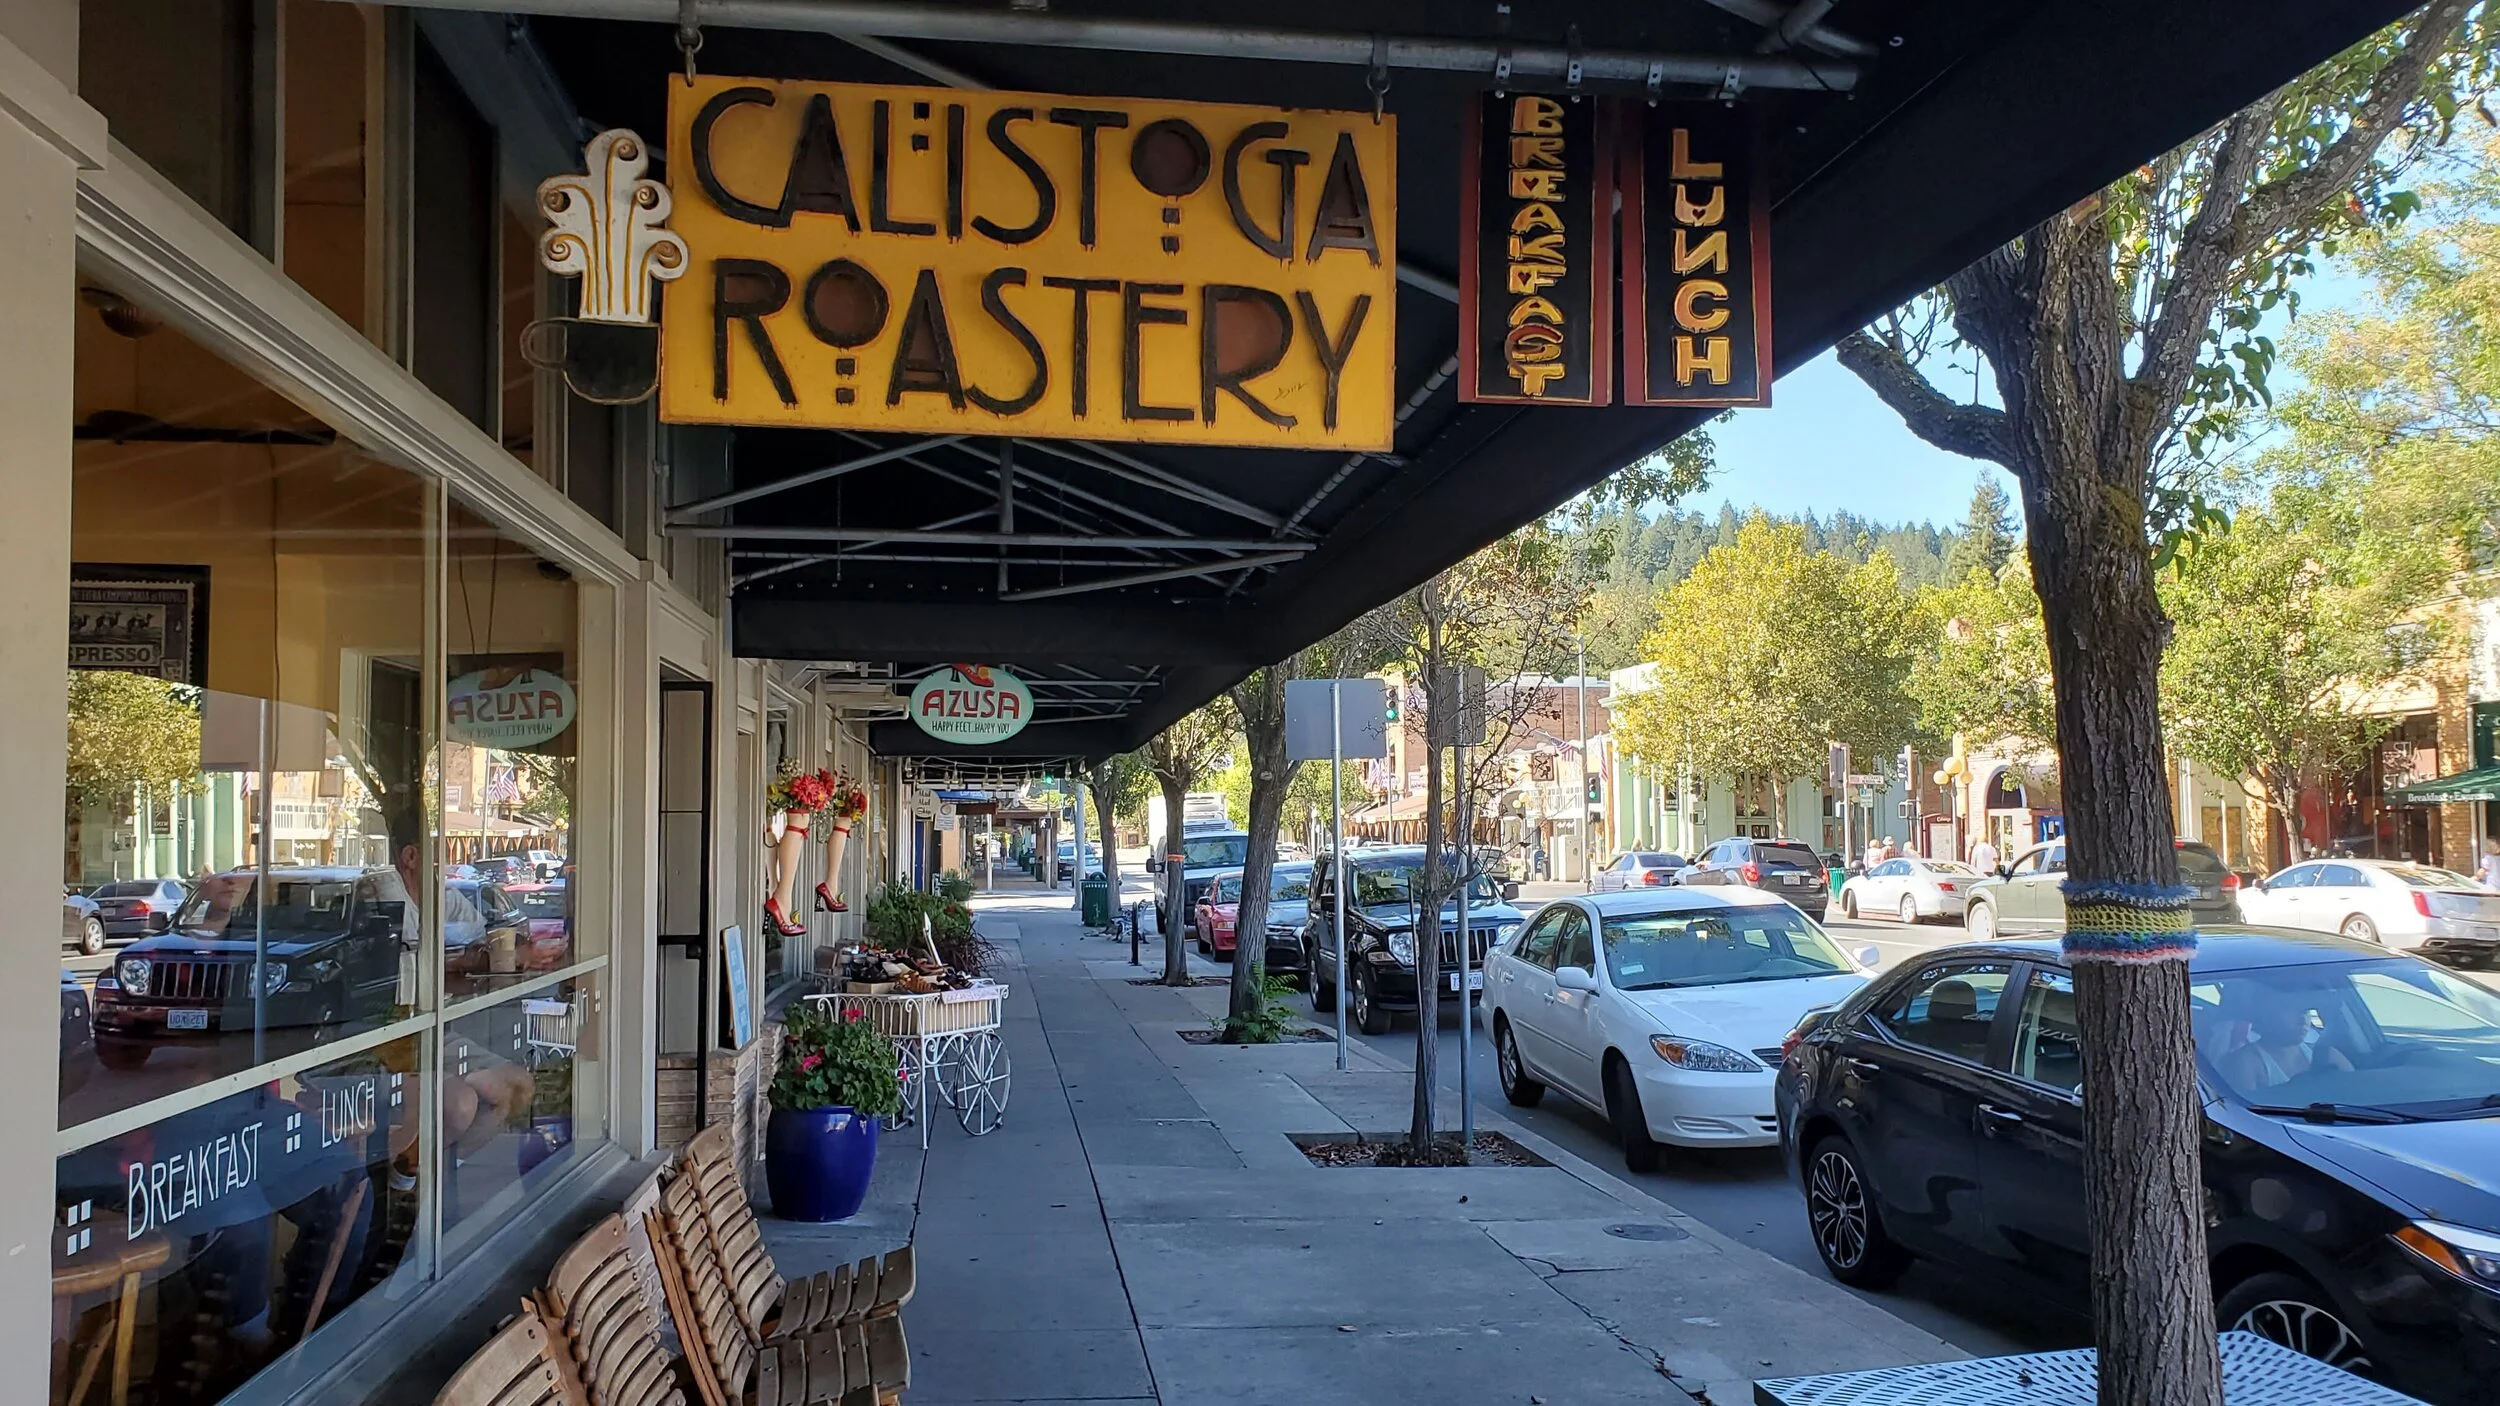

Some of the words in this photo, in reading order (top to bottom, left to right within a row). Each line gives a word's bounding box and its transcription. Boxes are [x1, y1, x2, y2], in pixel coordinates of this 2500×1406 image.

[690, 86, 1381, 268] CALISTOGA
[1504, 96, 1567, 397] BREAKFAST
[1671, 128, 1731, 387] LUNCH
[713, 256, 1372, 434] ROASTERY
[922, 689, 1020, 719] AZUSA
[932, 721, 953, 733] HAPPY
[997, 723, 1010, 734] YOU
[128, 1121, 262, 1241] BREAKFAST
[322, 1078, 375, 1148] LUNCH
